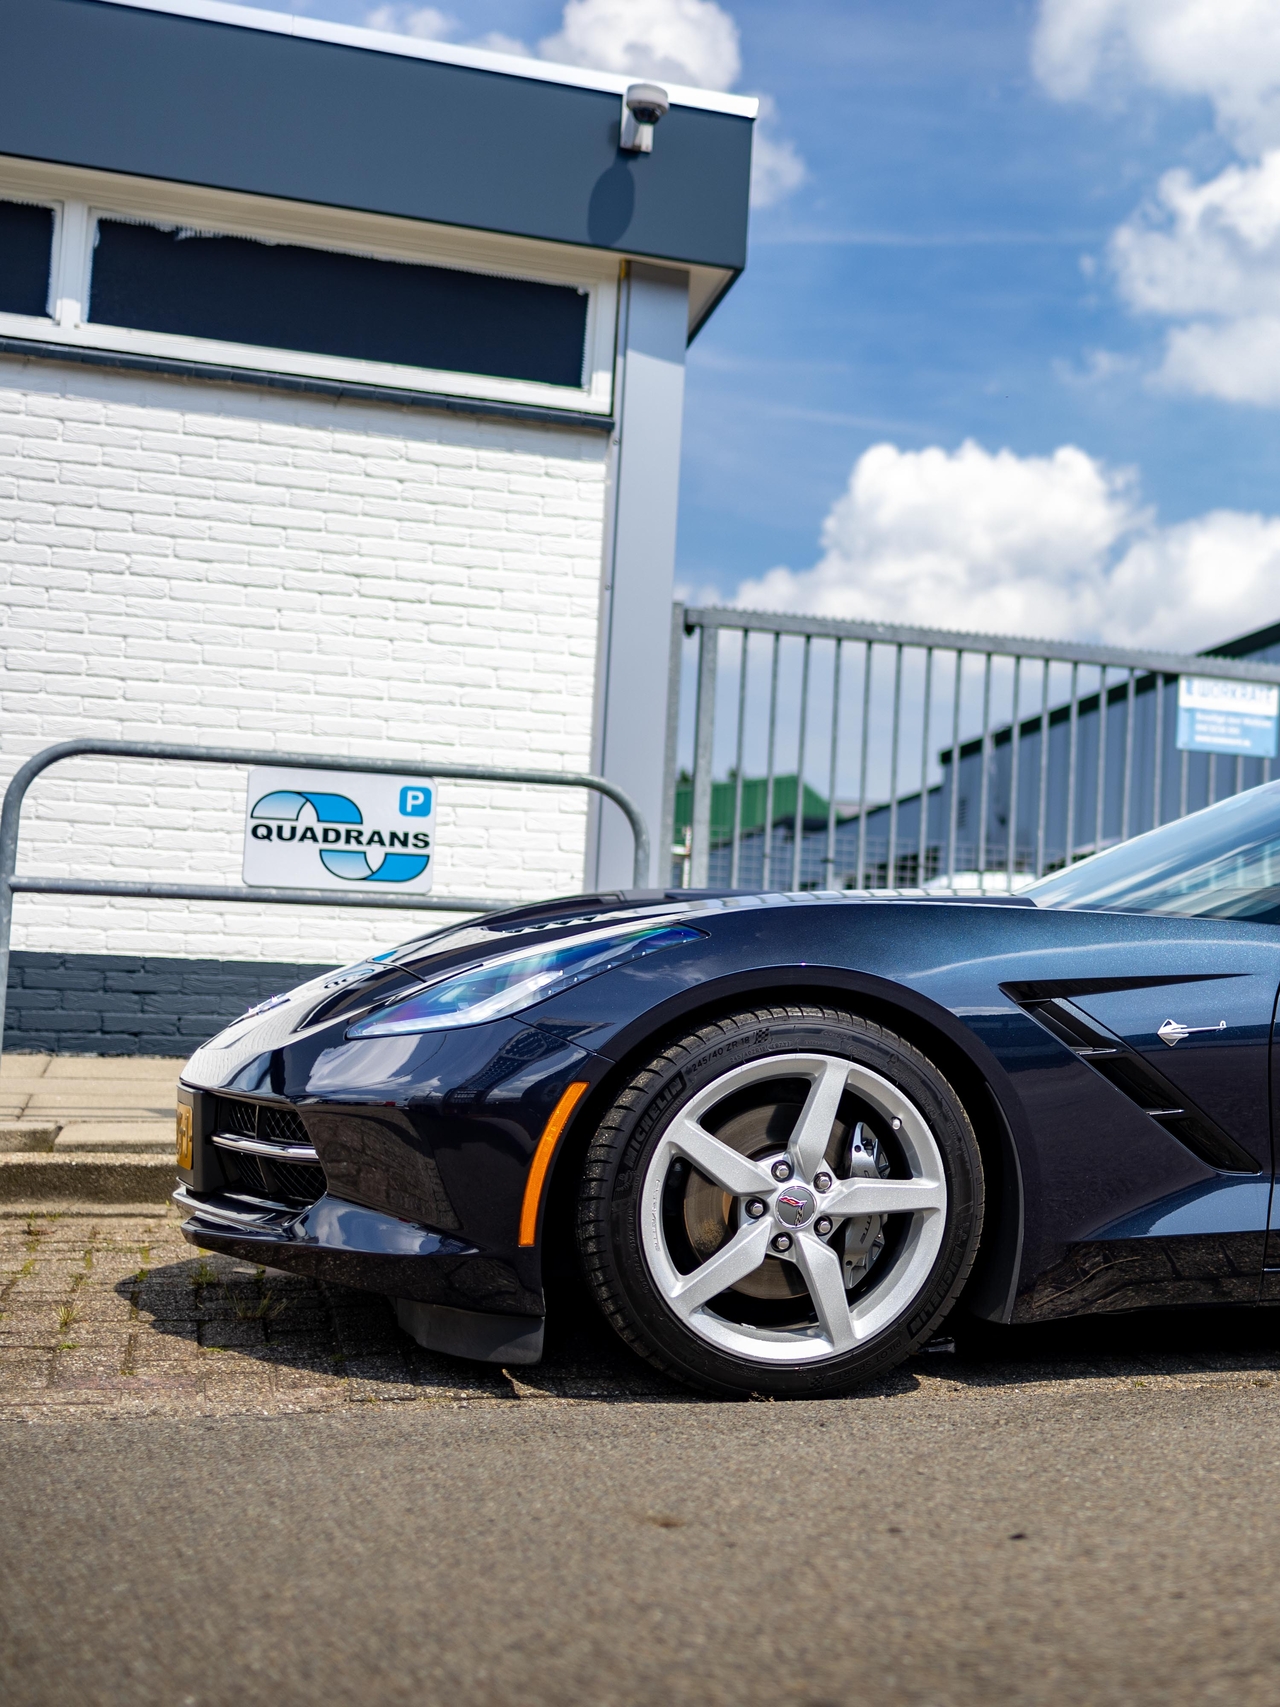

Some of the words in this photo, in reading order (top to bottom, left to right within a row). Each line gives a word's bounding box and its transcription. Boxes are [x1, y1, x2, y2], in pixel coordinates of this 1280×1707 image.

[406, 790, 424, 812] P
[251, 823, 431, 849] QUADRANS
[691, 1047, 724, 1072] 245/40
[726, 1040, 739, 1052] ZR
[741, 1036, 750, 1045] 18
[624, 1077, 684, 1169] MICHELIN
[909, 1245, 963, 1336] MICHELIN
[874, 1339, 902, 1364] PILOT
[837, 1359, 872, 1380] SPORT
